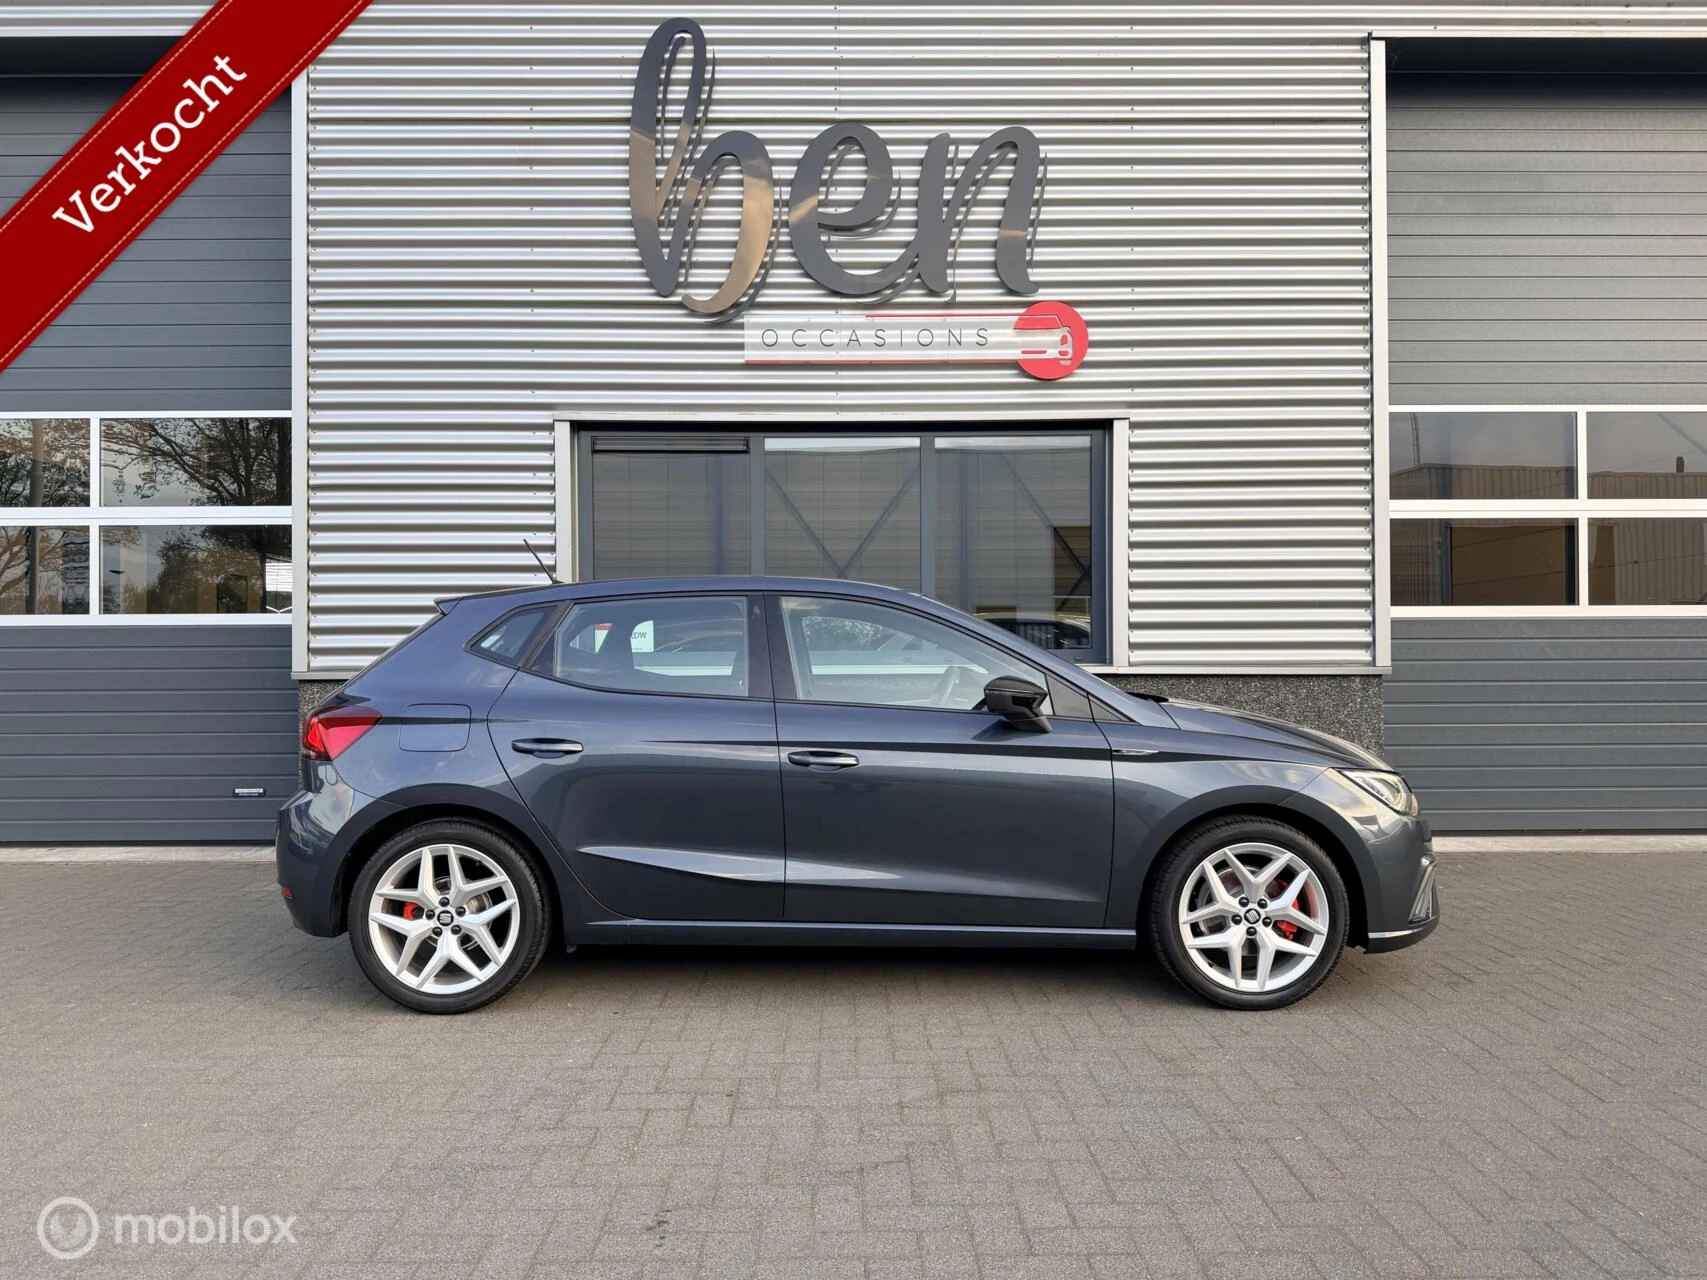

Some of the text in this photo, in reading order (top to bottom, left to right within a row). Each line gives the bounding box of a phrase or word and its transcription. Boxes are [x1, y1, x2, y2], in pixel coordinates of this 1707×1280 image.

[629, 17, 1040, 314] ben
[761, 328, 989, 348] OCCASIONS
[631, 631, 647, 640] DW
